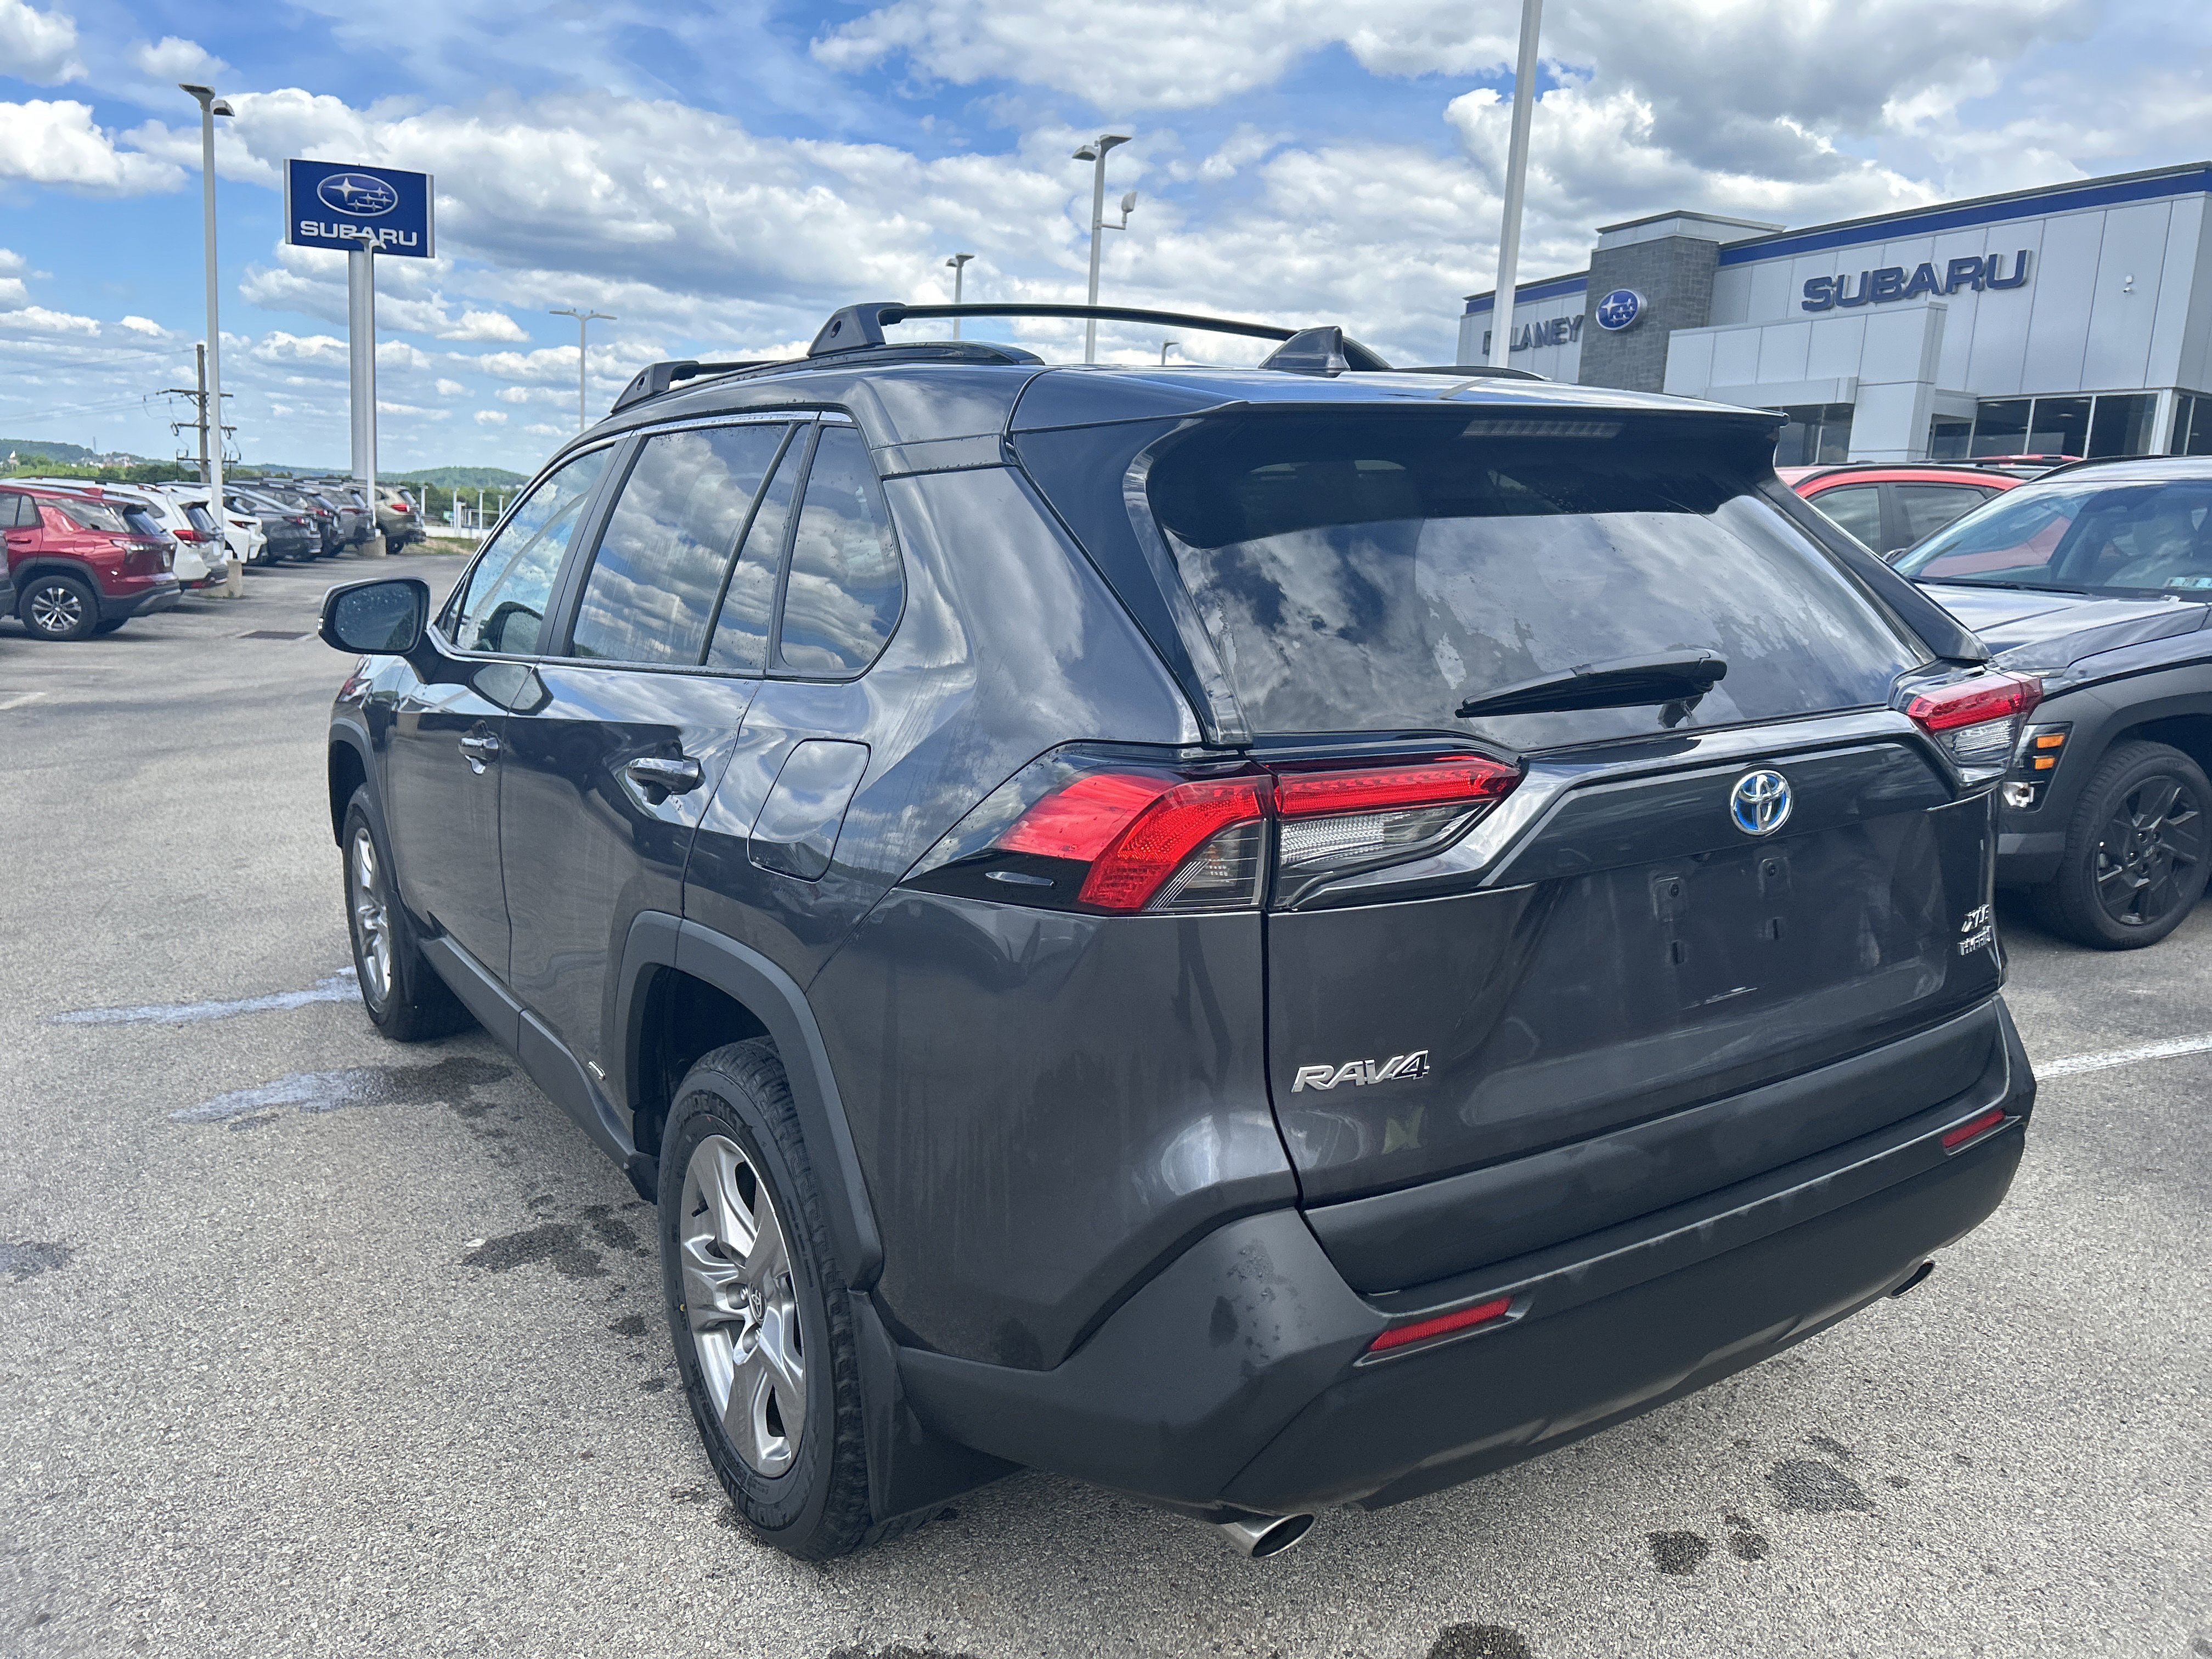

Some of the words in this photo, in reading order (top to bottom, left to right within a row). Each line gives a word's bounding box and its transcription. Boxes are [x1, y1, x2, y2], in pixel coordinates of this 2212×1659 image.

[300, 221, 417, 247] SUBARU
[1802, 250, 2032, 312] SUBARU
[1291, 1050, 1430, 1092] RAV4
